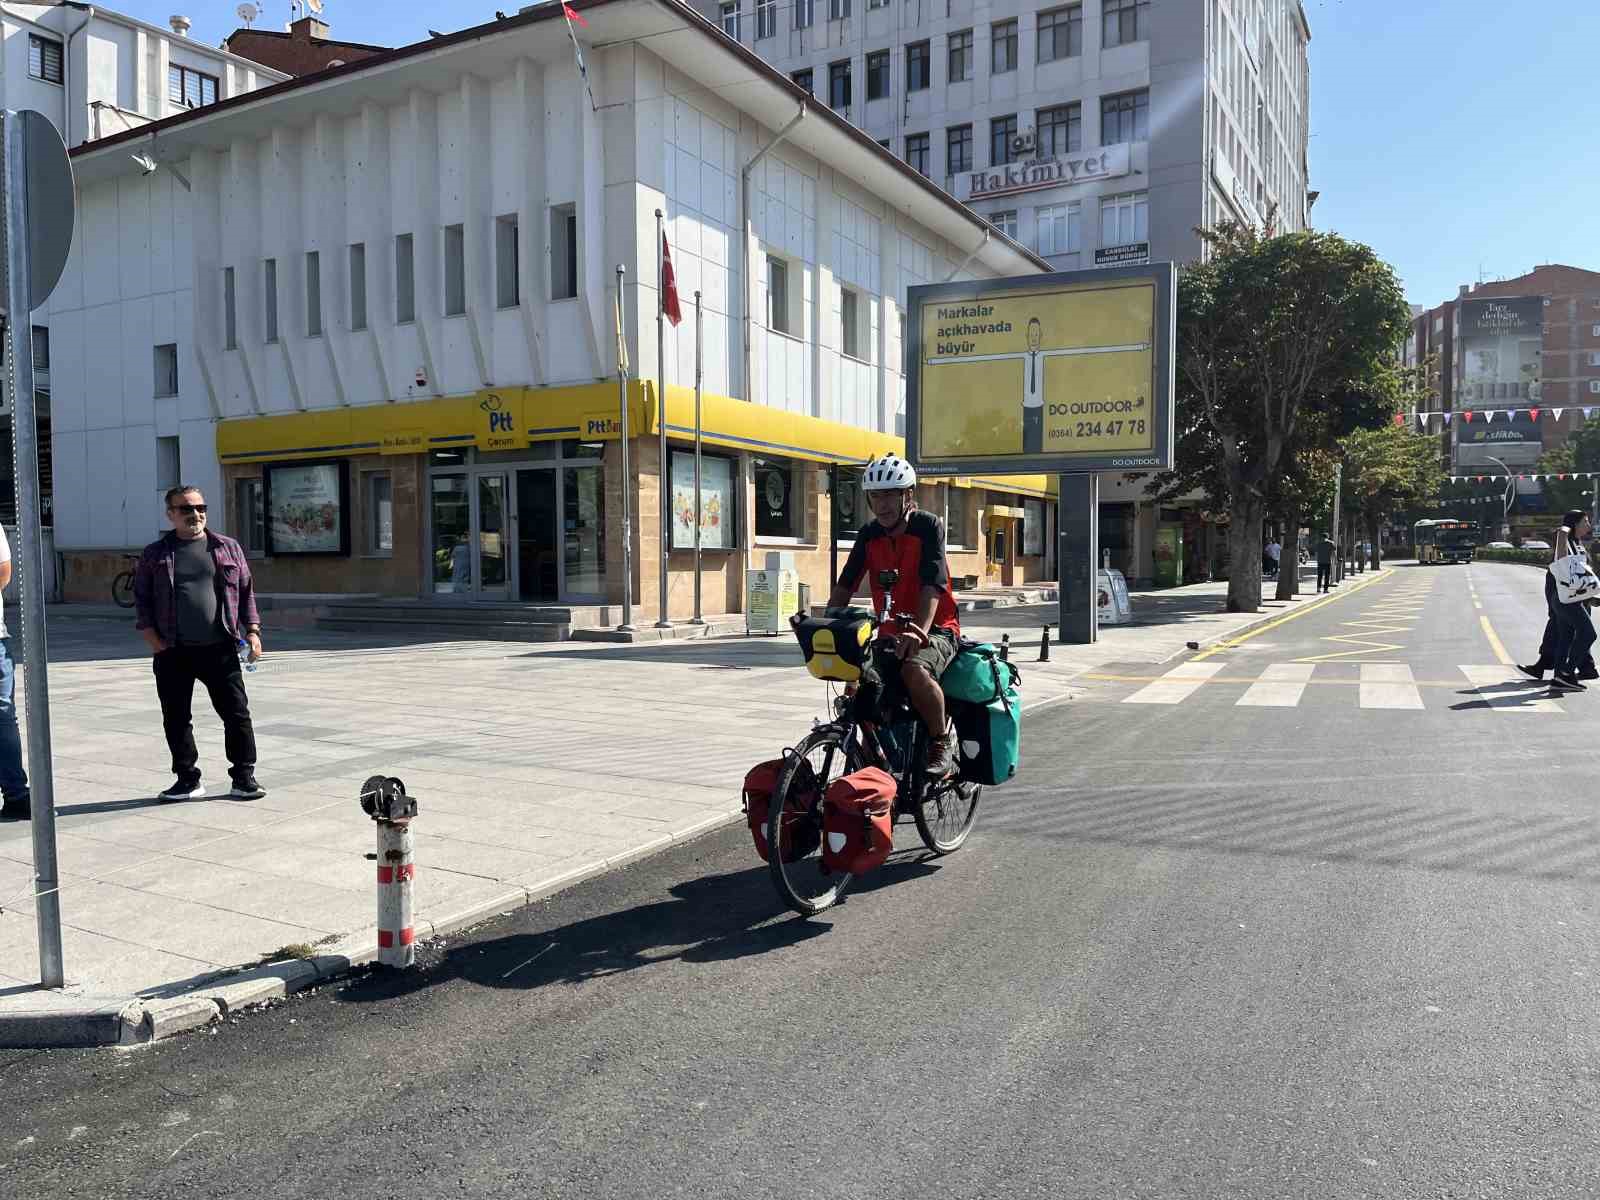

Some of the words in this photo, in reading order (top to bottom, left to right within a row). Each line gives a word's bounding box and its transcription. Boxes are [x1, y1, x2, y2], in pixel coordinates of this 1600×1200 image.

[937, 305, 994, 320] Markalar
[937, 320, 1012, 338] açıkhavada
[937, 340, 975, 355] büyür
[1049, 403, 1068, 416] DO
[1070, 400, 1132, 414] OUTDOOR
[490, 411, 514, 432] Ptt
[1076, 421, 1101, 437] 234
[1106, 420, 1123, 436] 47
[1127, 419, 1145, 435] 78
[1124, 457, 1160, 466] OUTDOOR
